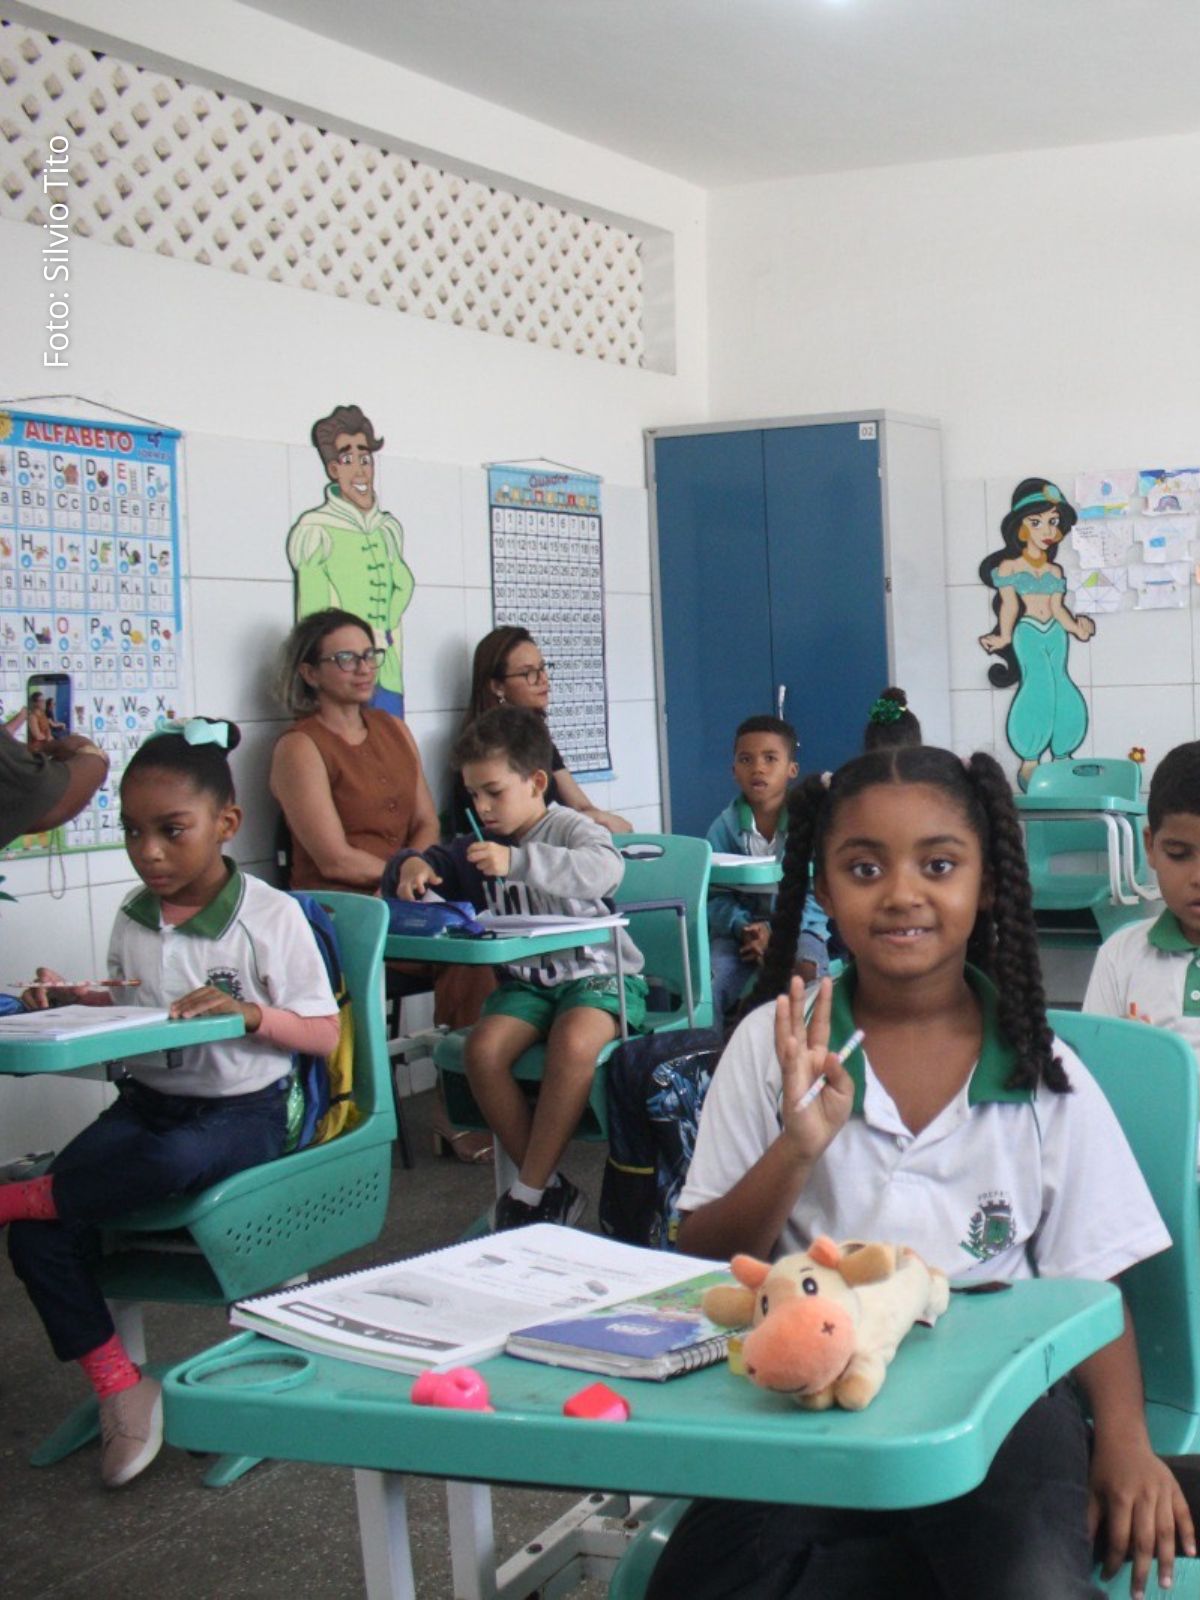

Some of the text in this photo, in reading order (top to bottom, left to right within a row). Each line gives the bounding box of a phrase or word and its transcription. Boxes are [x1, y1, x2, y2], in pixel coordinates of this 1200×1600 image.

[24, 420, 134, 453] ALFABETO
[18, 451, 155, 482] B C D E F
[21, 534, 157, 559] H I J K L
[24, 616, 160, 635] N O P Q R
[94, 696, 165, 713] V W X
